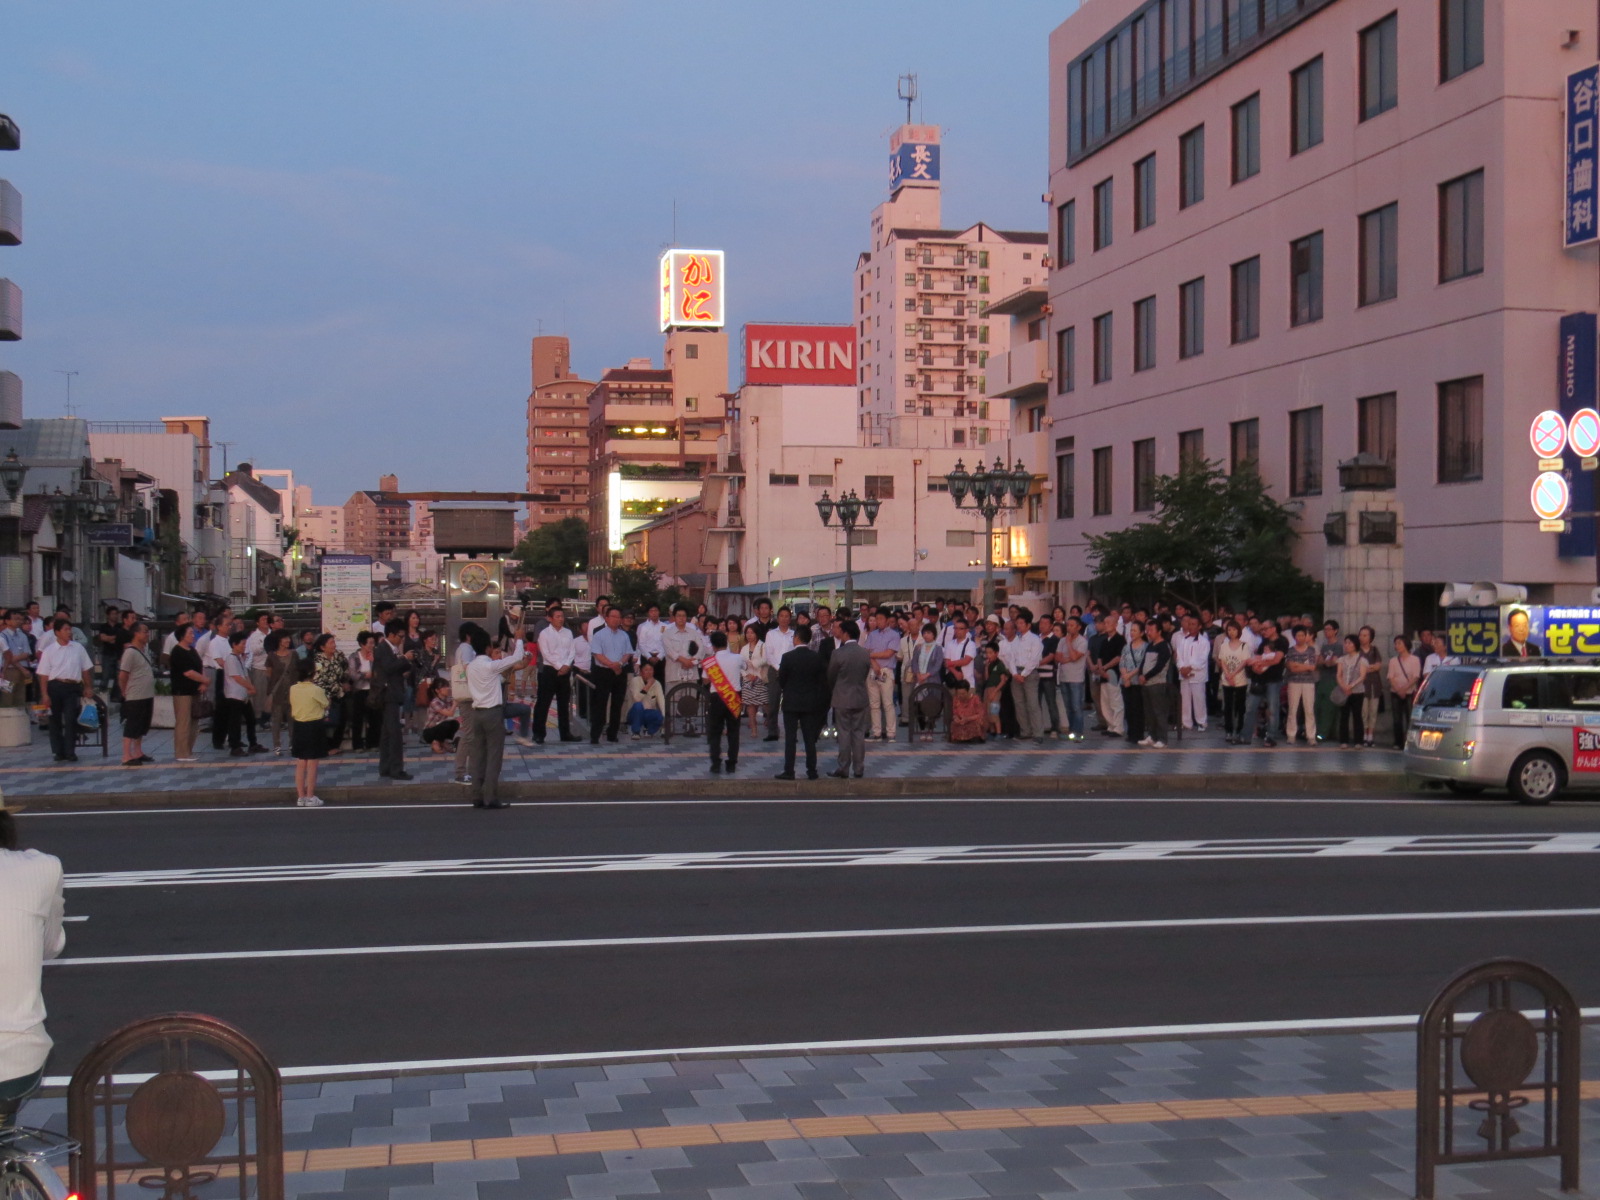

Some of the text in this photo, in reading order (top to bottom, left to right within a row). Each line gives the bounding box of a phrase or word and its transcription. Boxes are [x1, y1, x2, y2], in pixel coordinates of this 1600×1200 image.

[910, 144, 932, 179] 長久
[681, 254, 713, 321] かに
[750, 339, 853, 370] KIRIN
[1566, 334, 1576, 398] MIZUHO
[1448, 622, 1499, 654] せこう
